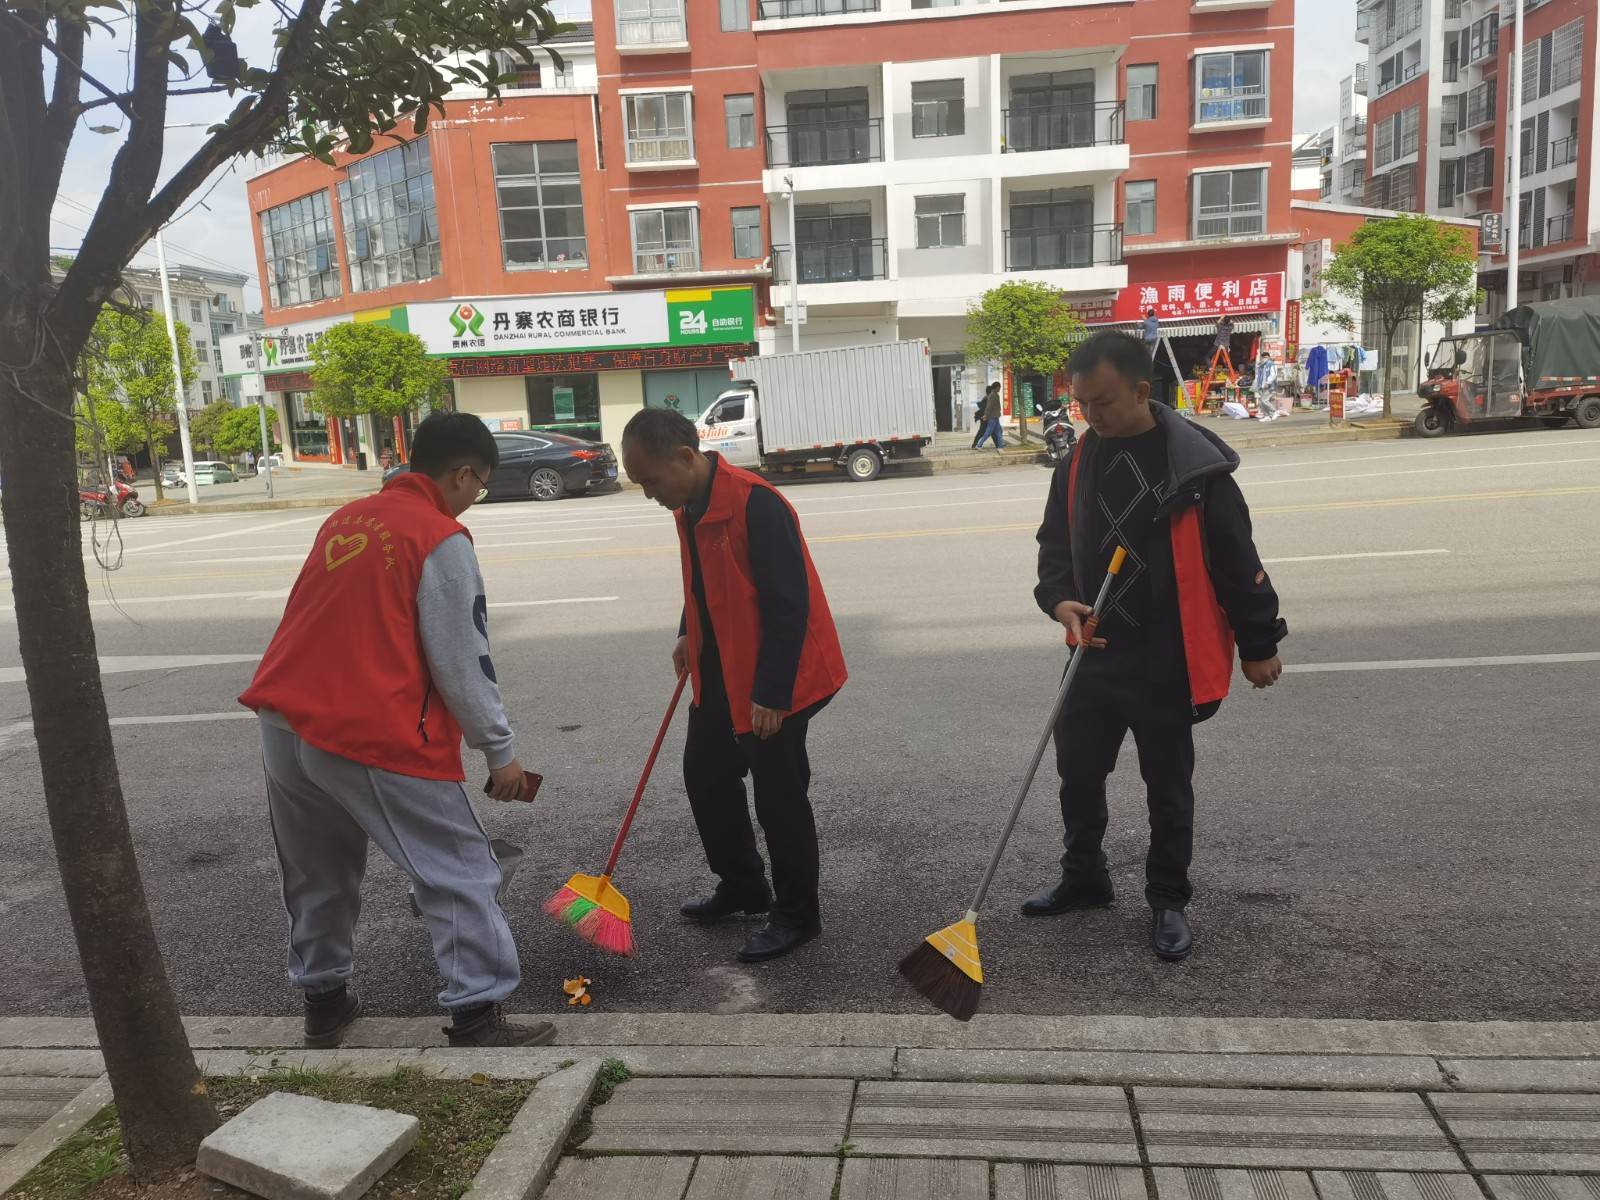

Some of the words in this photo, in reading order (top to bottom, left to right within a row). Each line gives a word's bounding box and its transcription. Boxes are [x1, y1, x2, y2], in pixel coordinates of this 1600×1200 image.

[493, 307, 619, 331] 丹寨农商银行
[679, 310, 708, 334] 24
[452, 338, 486, 349] 贵州农信
[493, 332, 527, 341] DANZHAI
[528, 331, 552, 339] RURAL
[553, 328, 604, 338] COMMERCIAL
[605, 327, 627, 336] BANK
